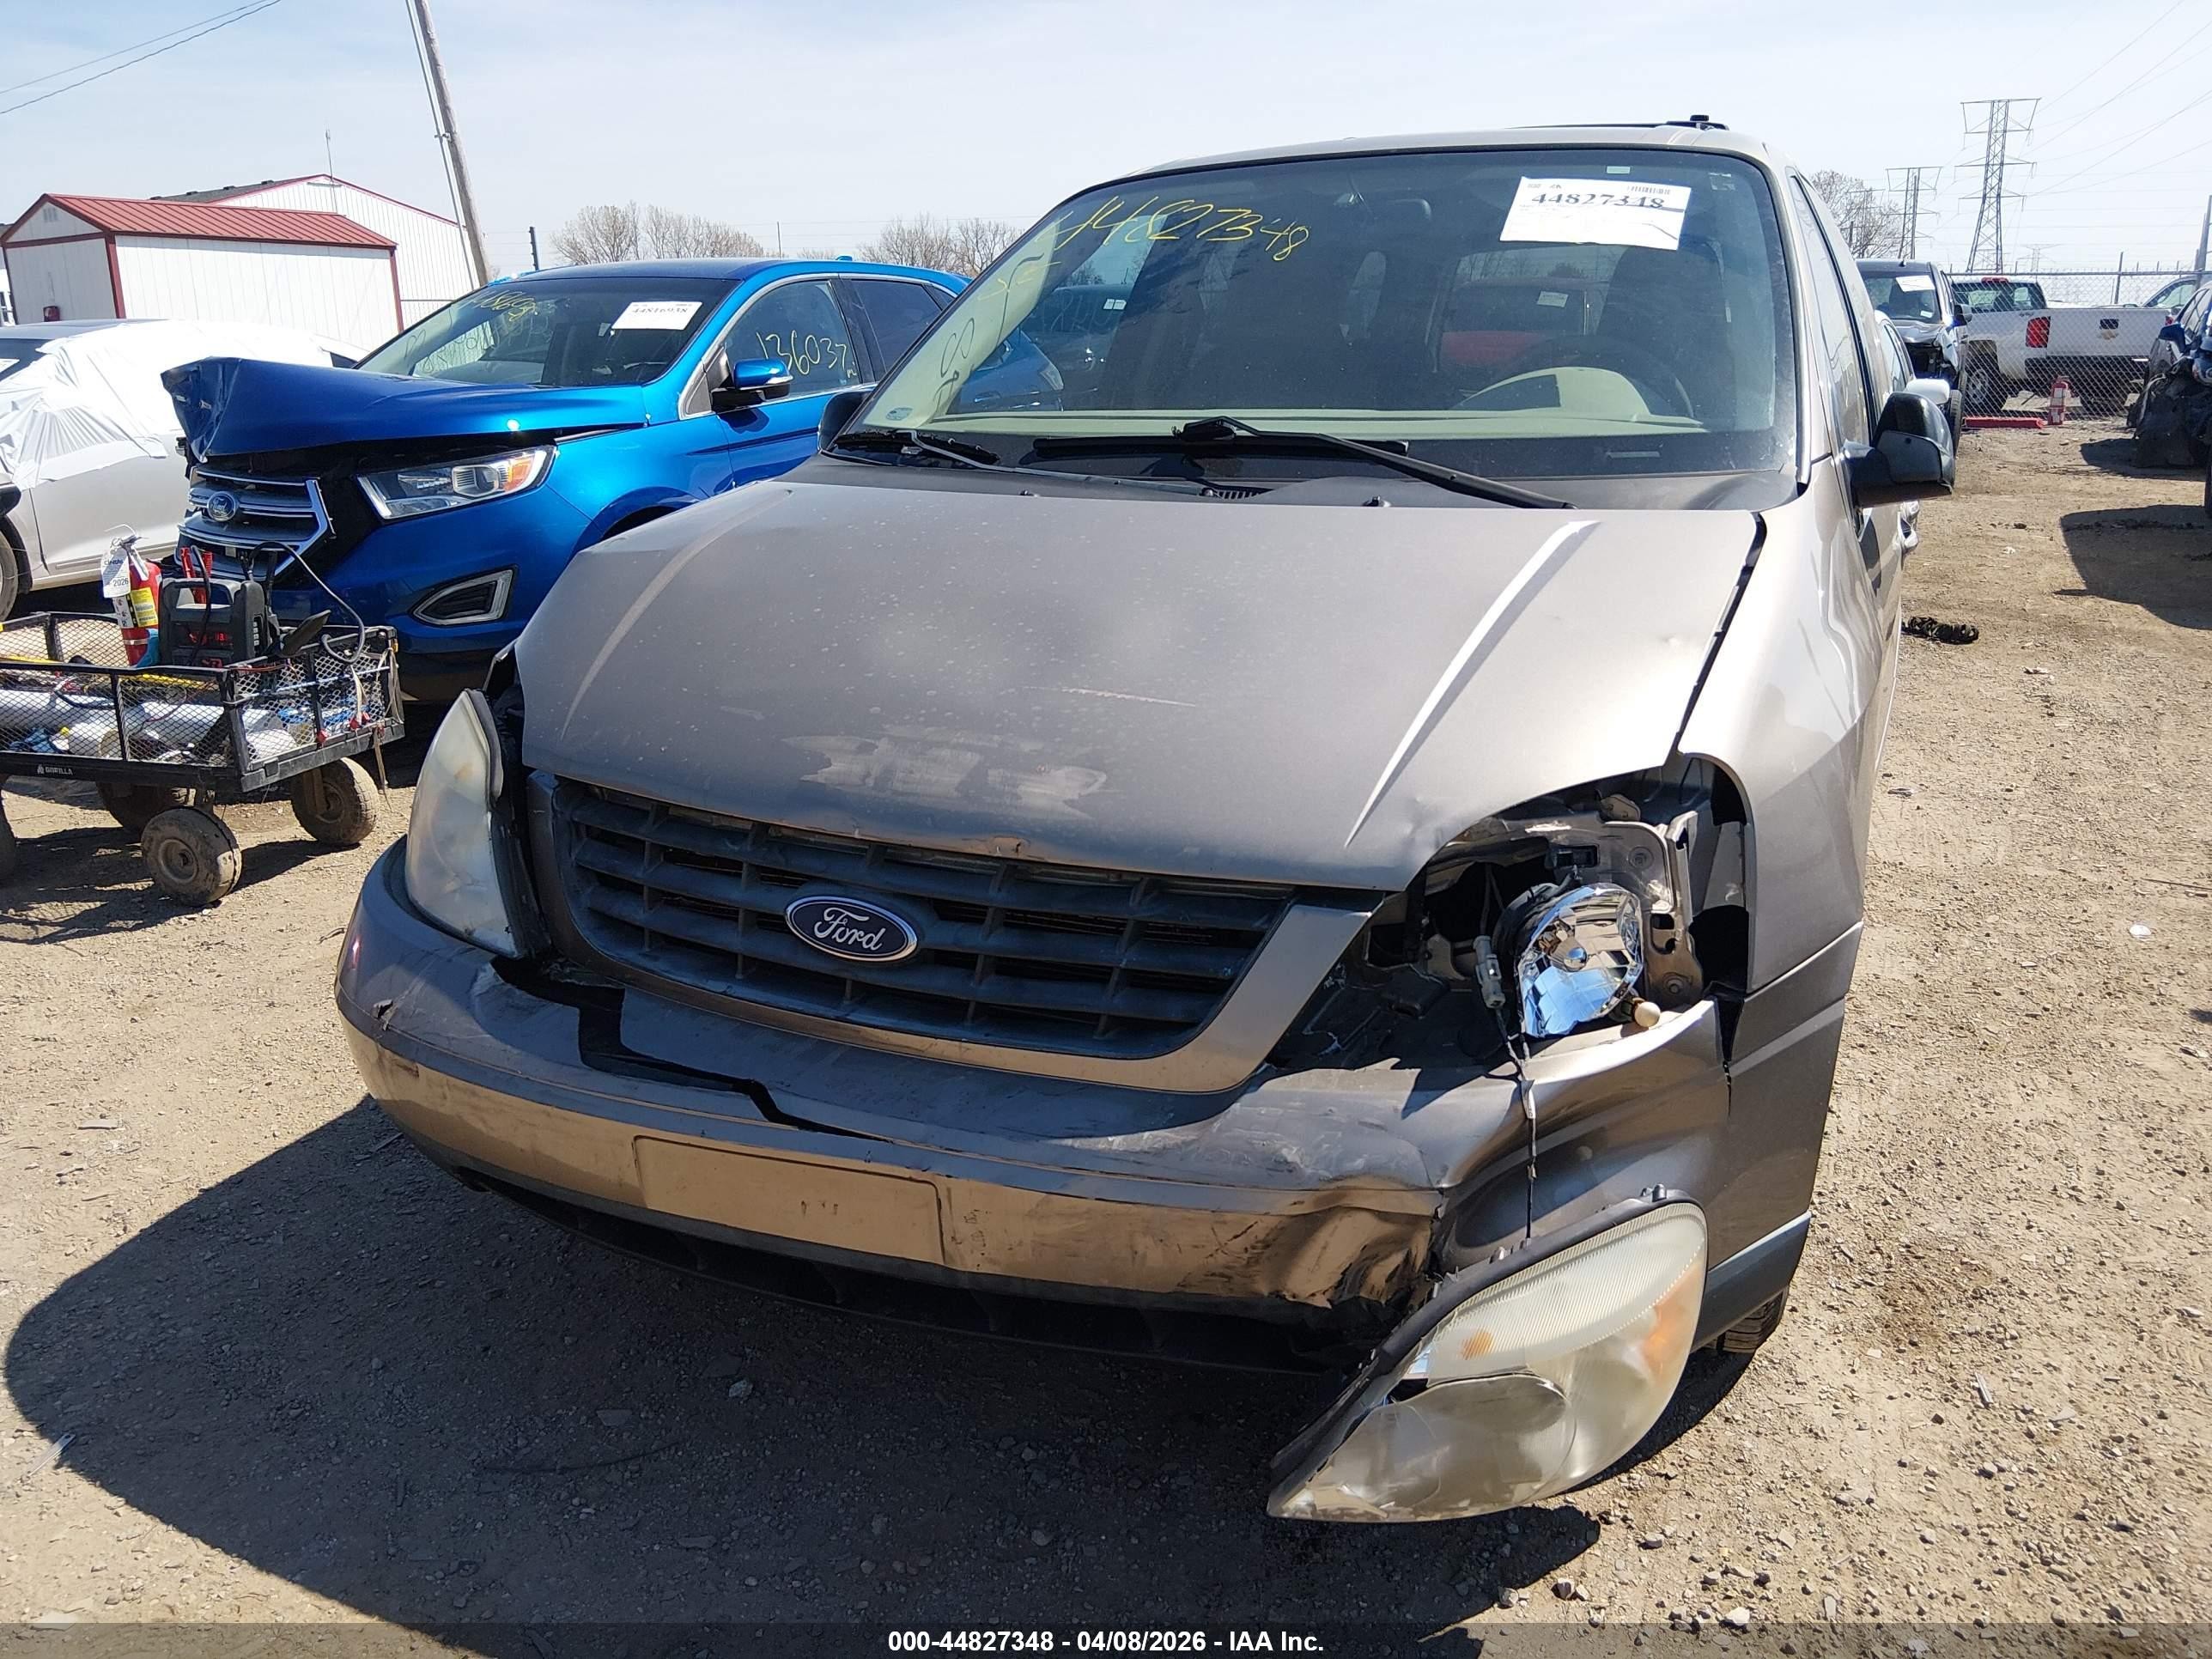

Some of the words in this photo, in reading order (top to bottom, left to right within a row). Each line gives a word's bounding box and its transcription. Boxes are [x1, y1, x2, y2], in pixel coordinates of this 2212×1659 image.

[1531, 192, 1666, 209] 44827348
[756, 330, 847, 375] 136037
[112, 577, 130, 587] 2026
[45, 766, 74, 775] GORILLA
[814, 907, 886, 951] Ford
